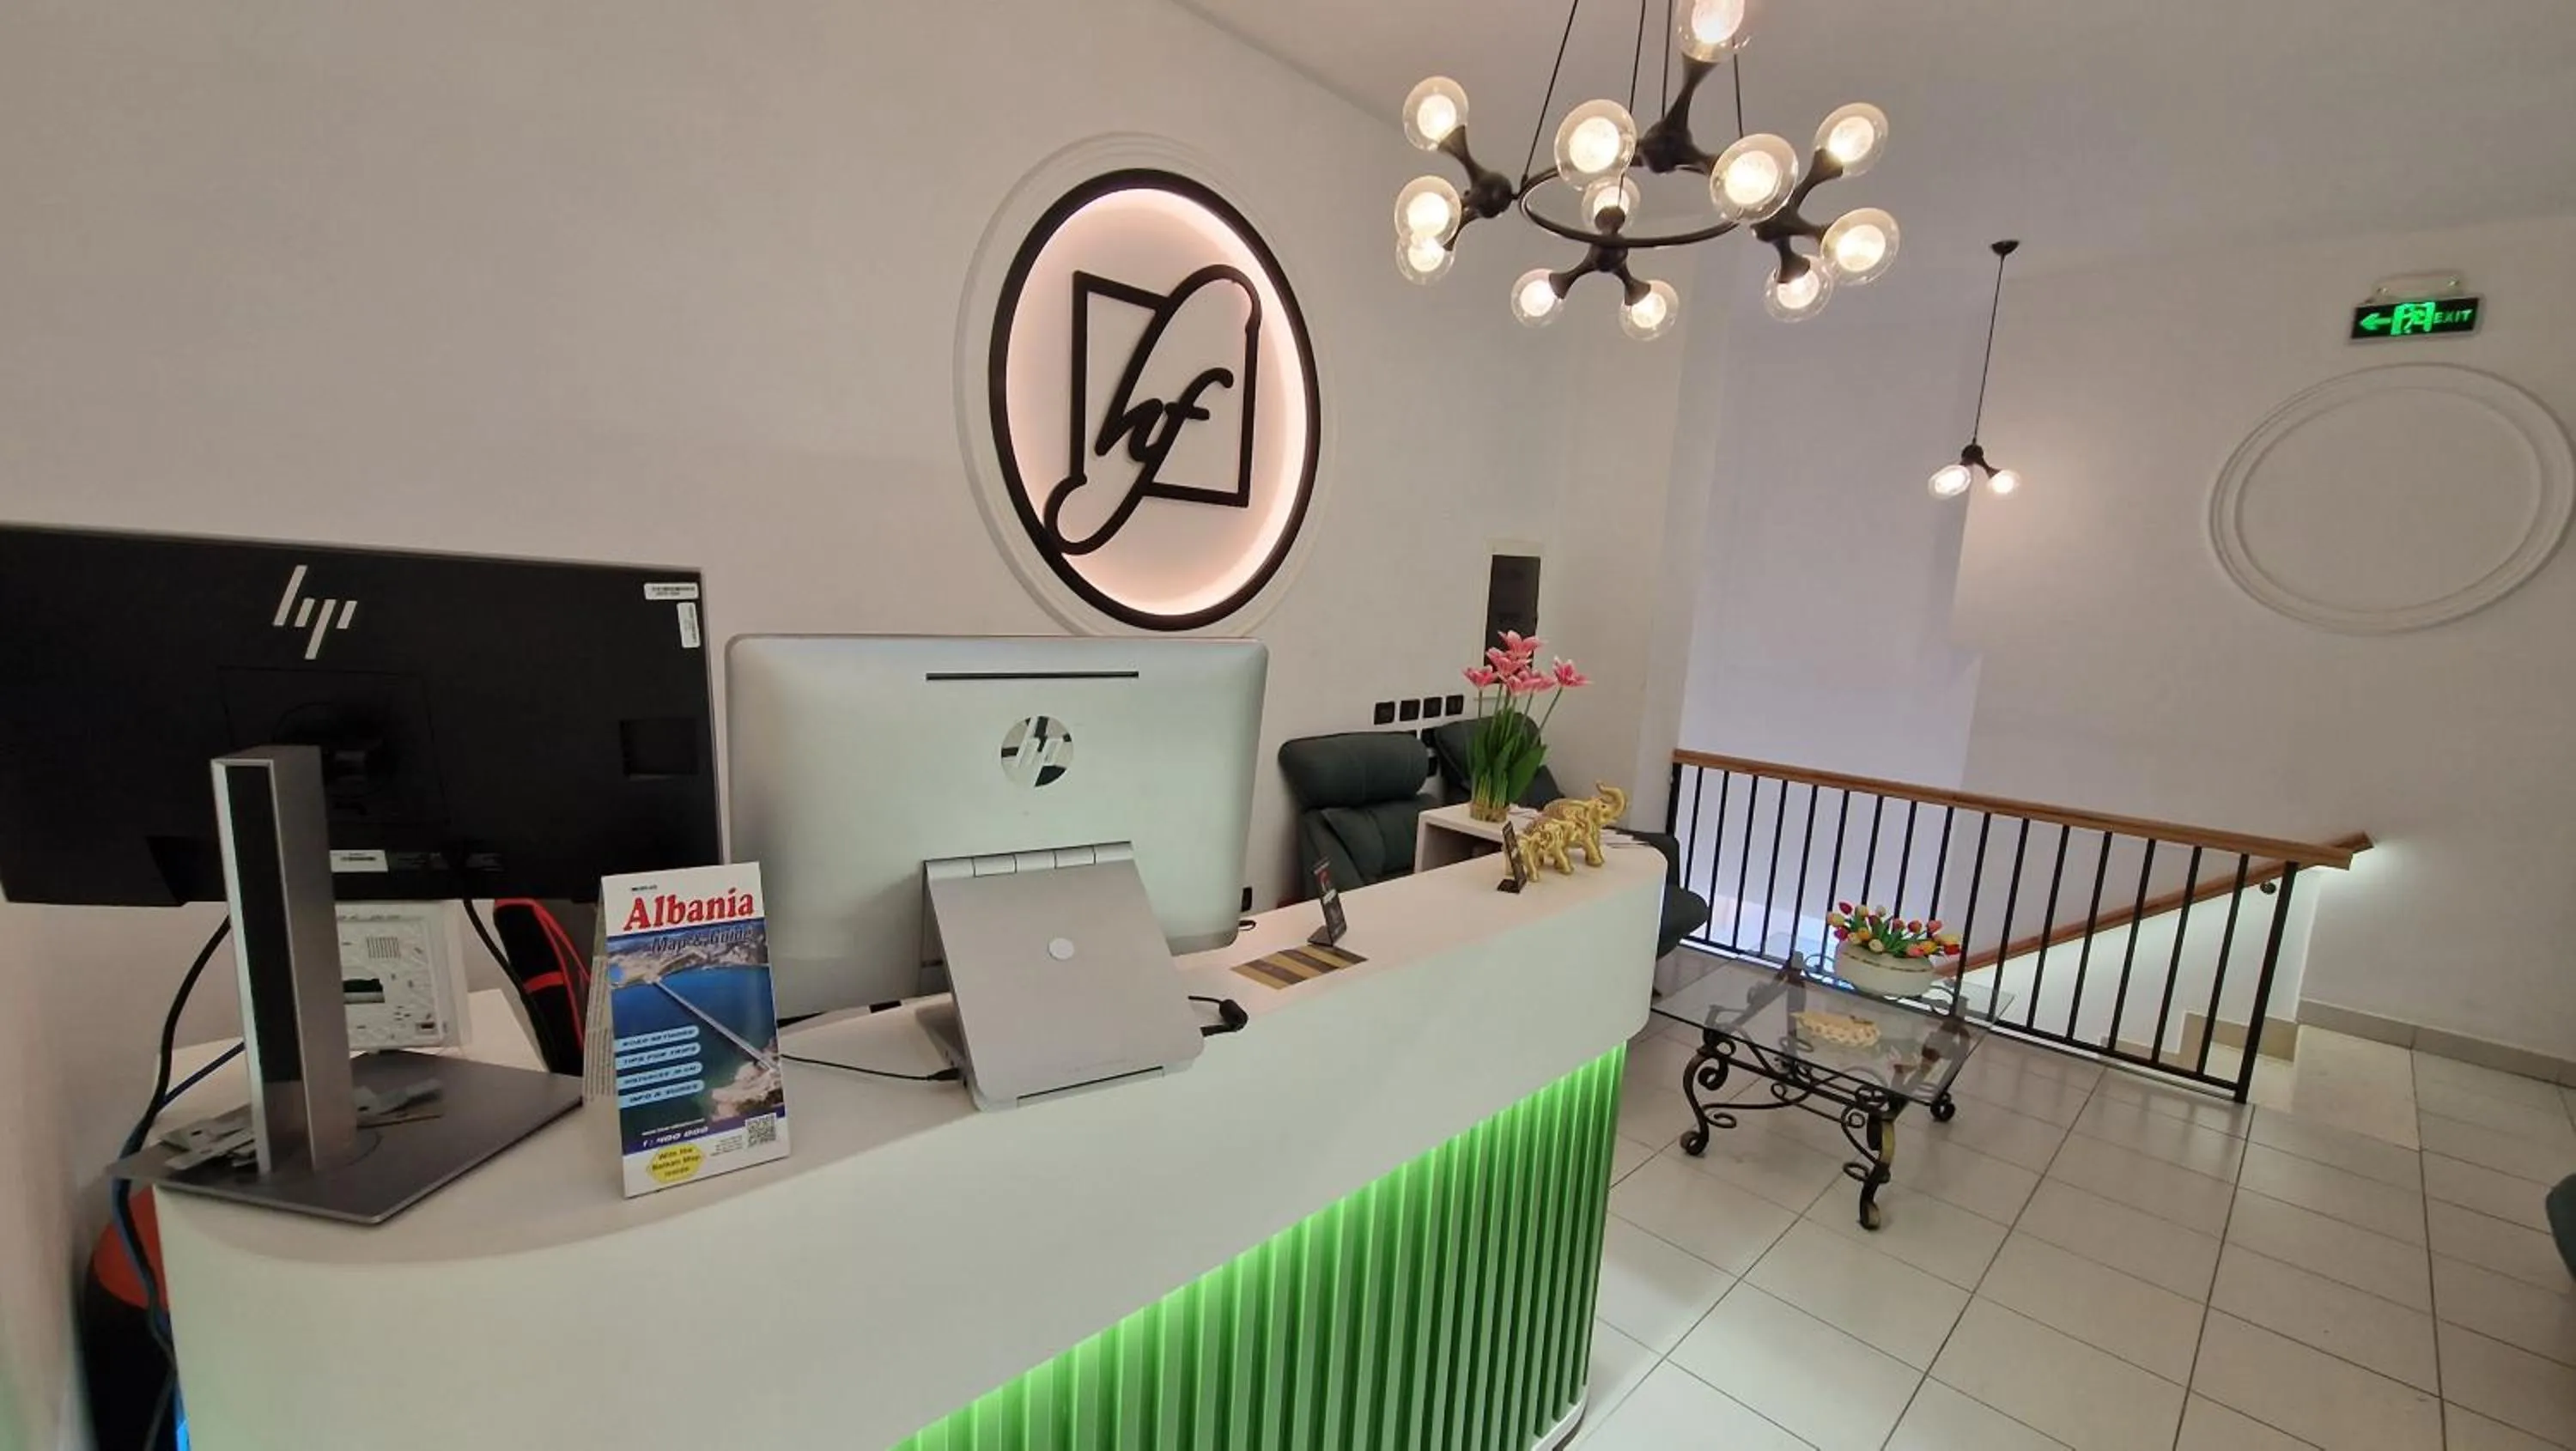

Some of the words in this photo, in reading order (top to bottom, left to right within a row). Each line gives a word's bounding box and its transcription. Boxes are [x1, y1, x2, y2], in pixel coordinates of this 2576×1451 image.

[2433, 309, 2472, 324] EXIT
[272, 565, 358, 659] hp
[651, 936, 686, 954] Map
